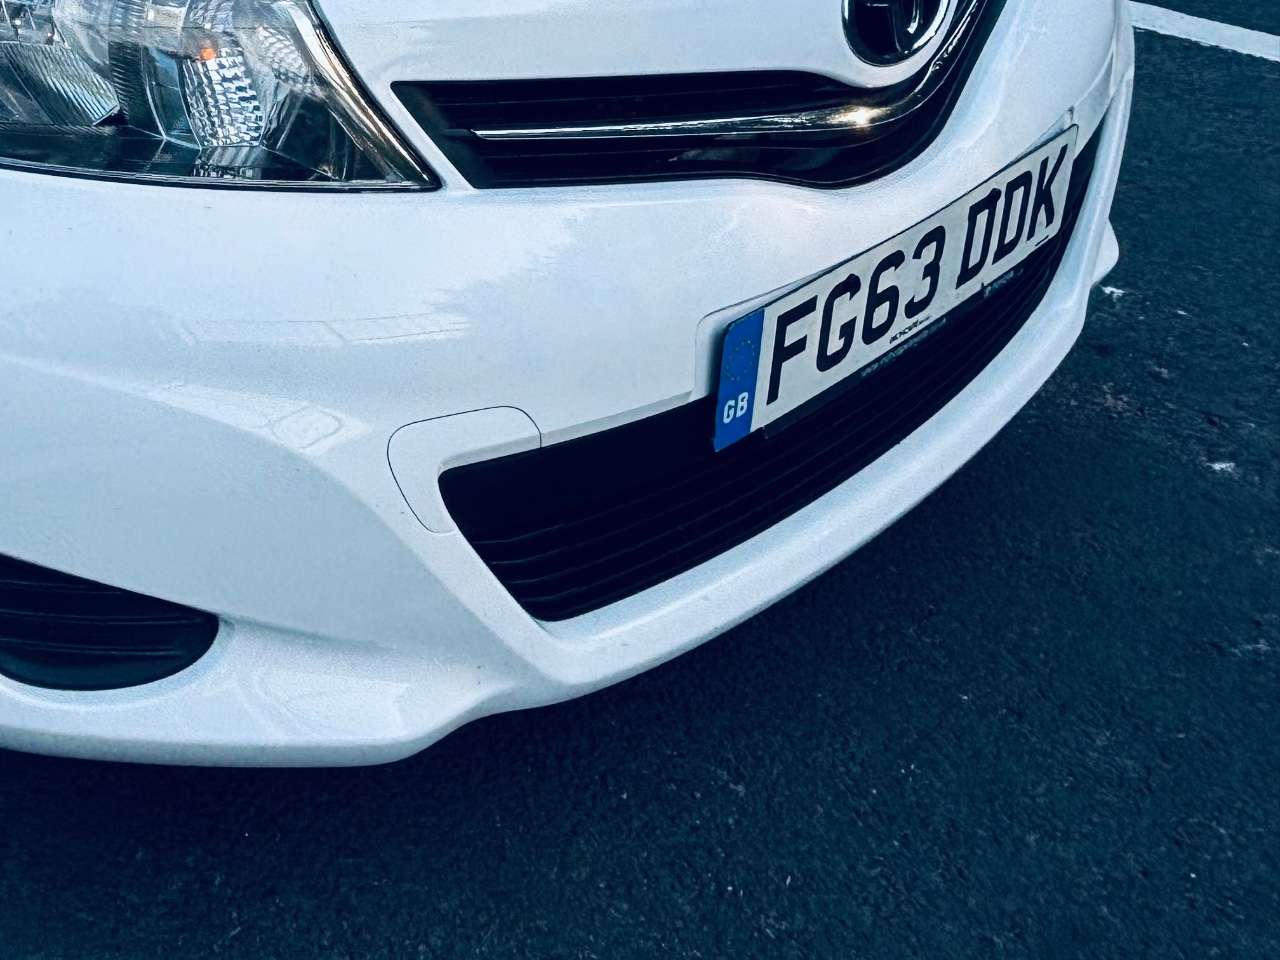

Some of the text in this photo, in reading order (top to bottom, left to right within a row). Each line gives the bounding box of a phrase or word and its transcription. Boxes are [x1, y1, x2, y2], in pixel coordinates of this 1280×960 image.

[767, 144, 1068, 406] FG63 DDK
[723, 391, 749, 424] GB
